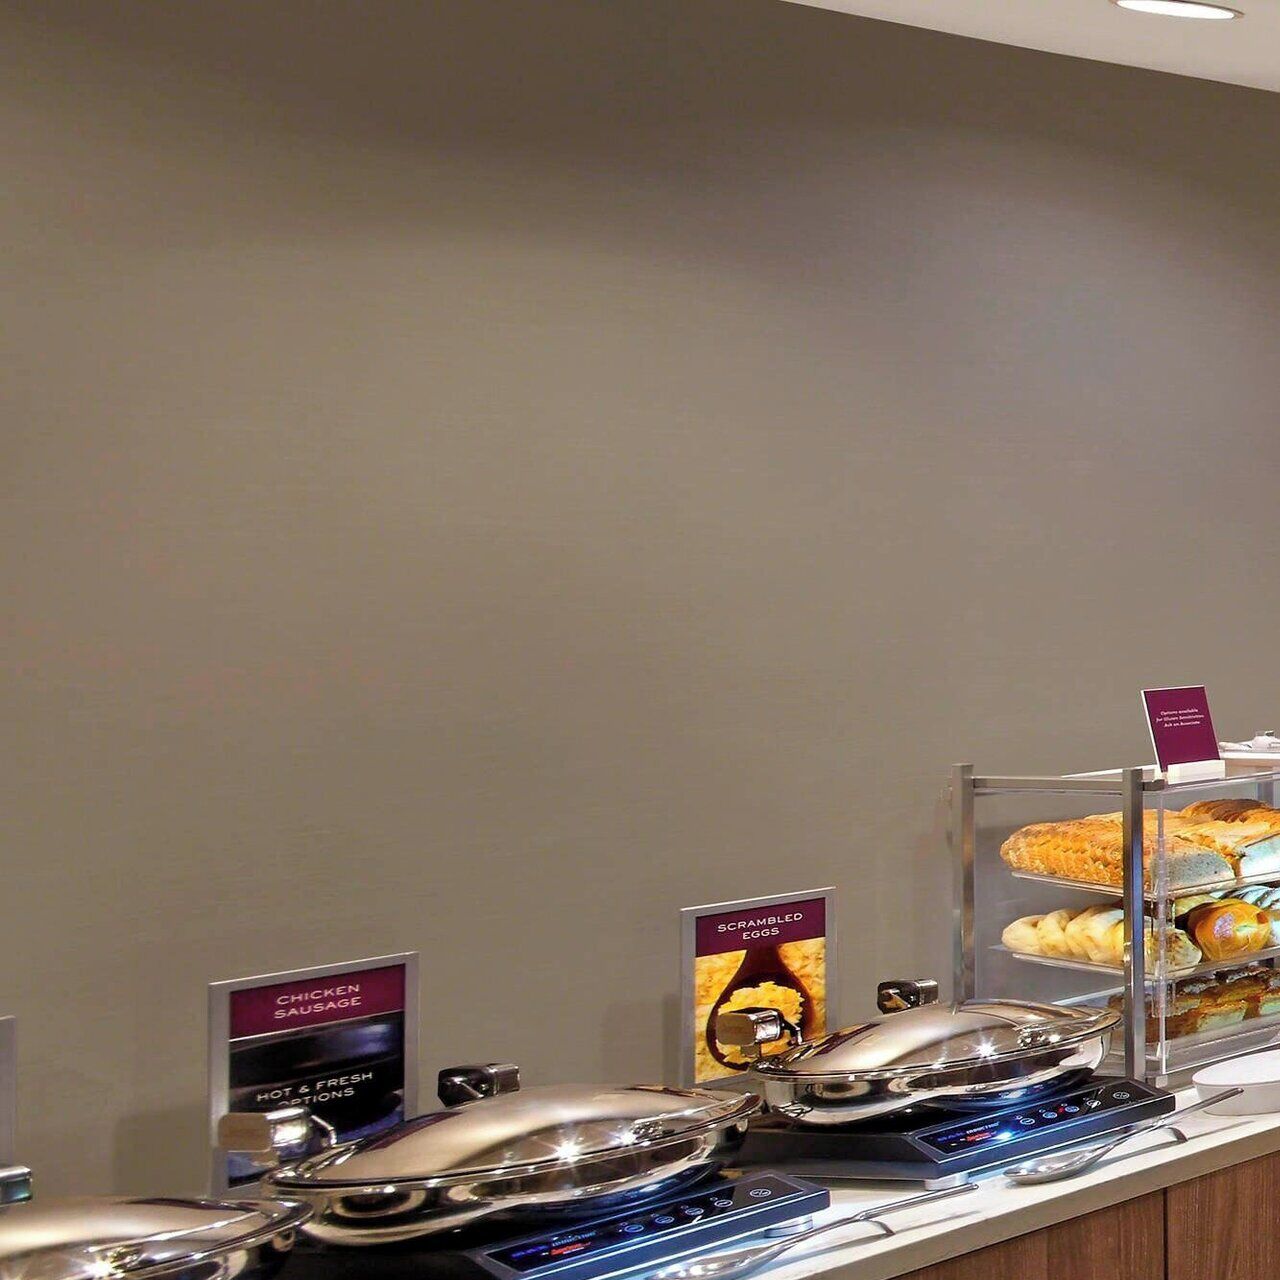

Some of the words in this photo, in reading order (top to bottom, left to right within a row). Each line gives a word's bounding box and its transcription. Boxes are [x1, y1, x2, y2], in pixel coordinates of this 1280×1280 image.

[717, 912, 803, 933] SCRAMBLED
[742, 927, 780, 940] EGGS
[276, 984, 360, 1005] CHICKEN
[273, 996, 362, 1019] SAUSAGE
[256, 1087, 293, 1102] HOT
[299, 1084, 310, 1093] &
[316, 1071, 373, 1089] FRESH
